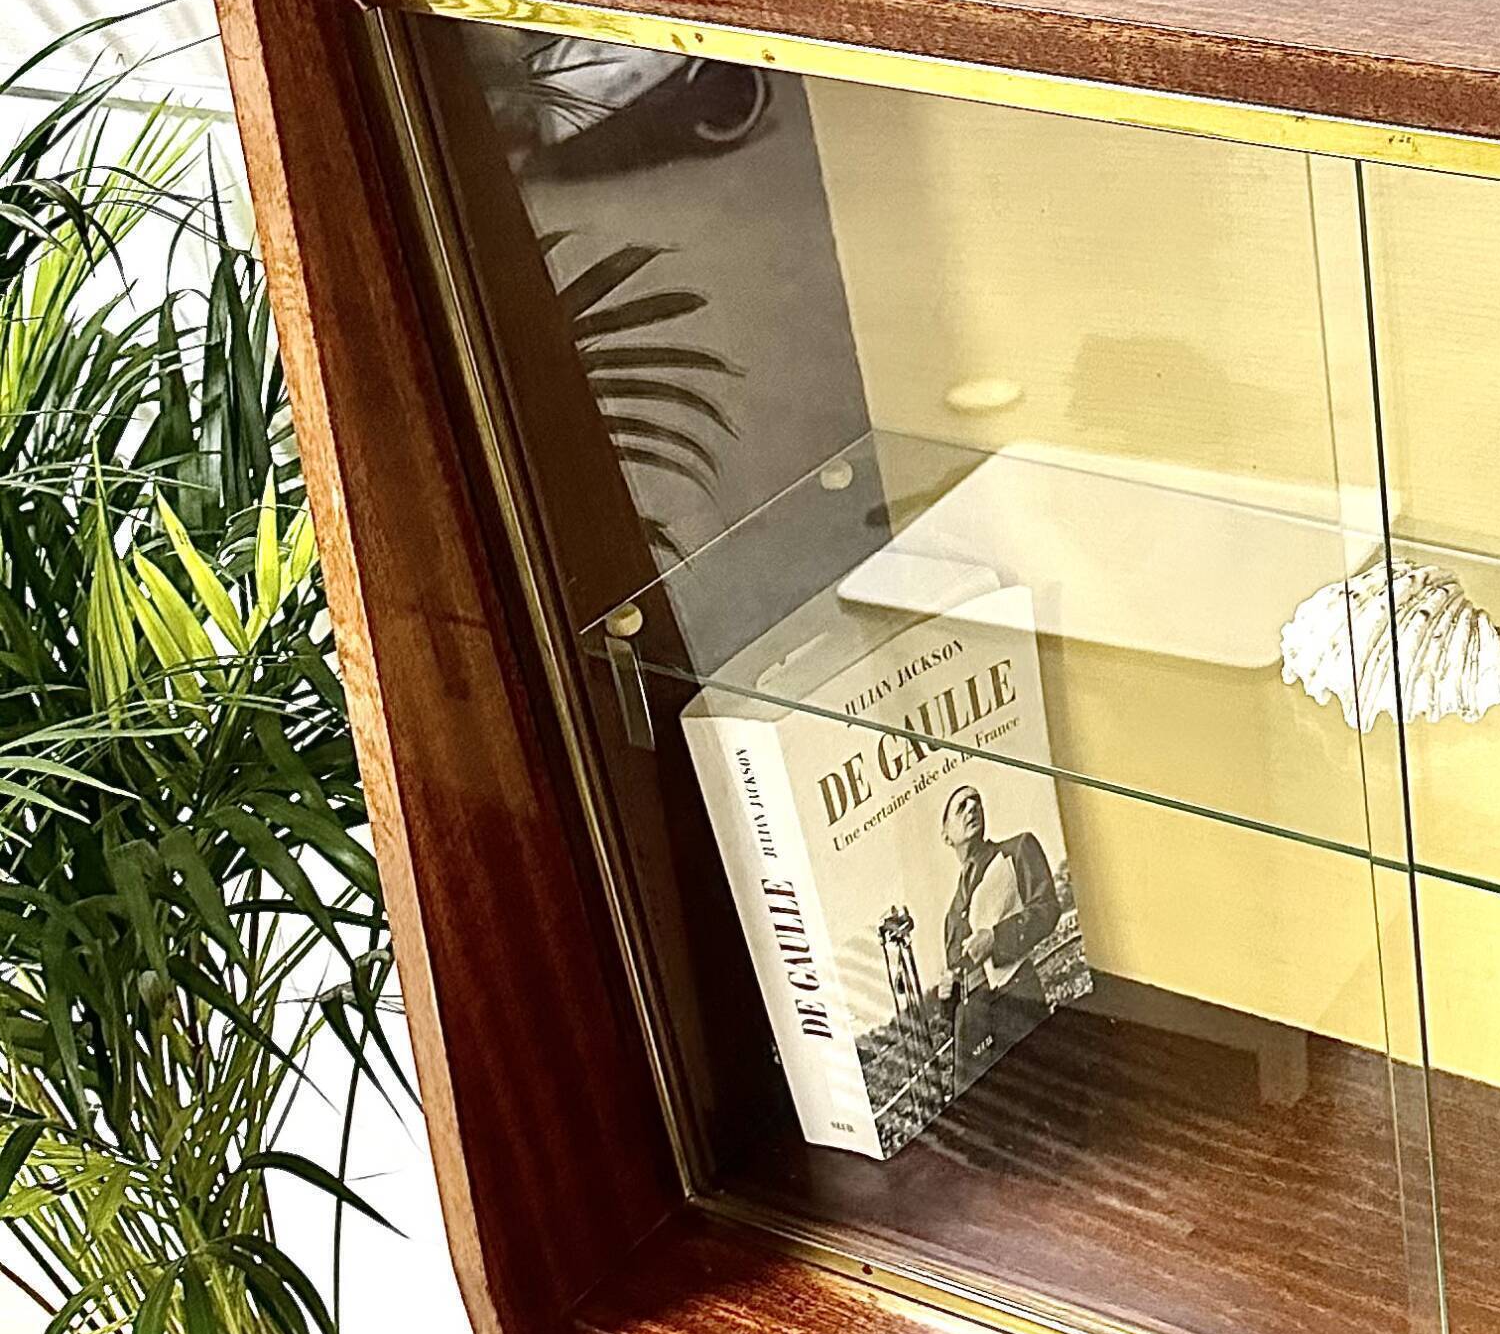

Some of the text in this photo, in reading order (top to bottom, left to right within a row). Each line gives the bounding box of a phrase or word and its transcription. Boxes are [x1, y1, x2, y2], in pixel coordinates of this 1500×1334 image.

[816, 658, 1017, 827] DE GAULLE
[844, 639, 964, 728] JULIAN JACKSON
[833, 826, 861, 852] Une
[863, 789, 912, 832] certaine
[913, 769, 940, 795] idée
[942, 753, 958, 775] de
[975, 716, 1021, 748] France
[761, 878, 834, 1040] DE GAULLE
